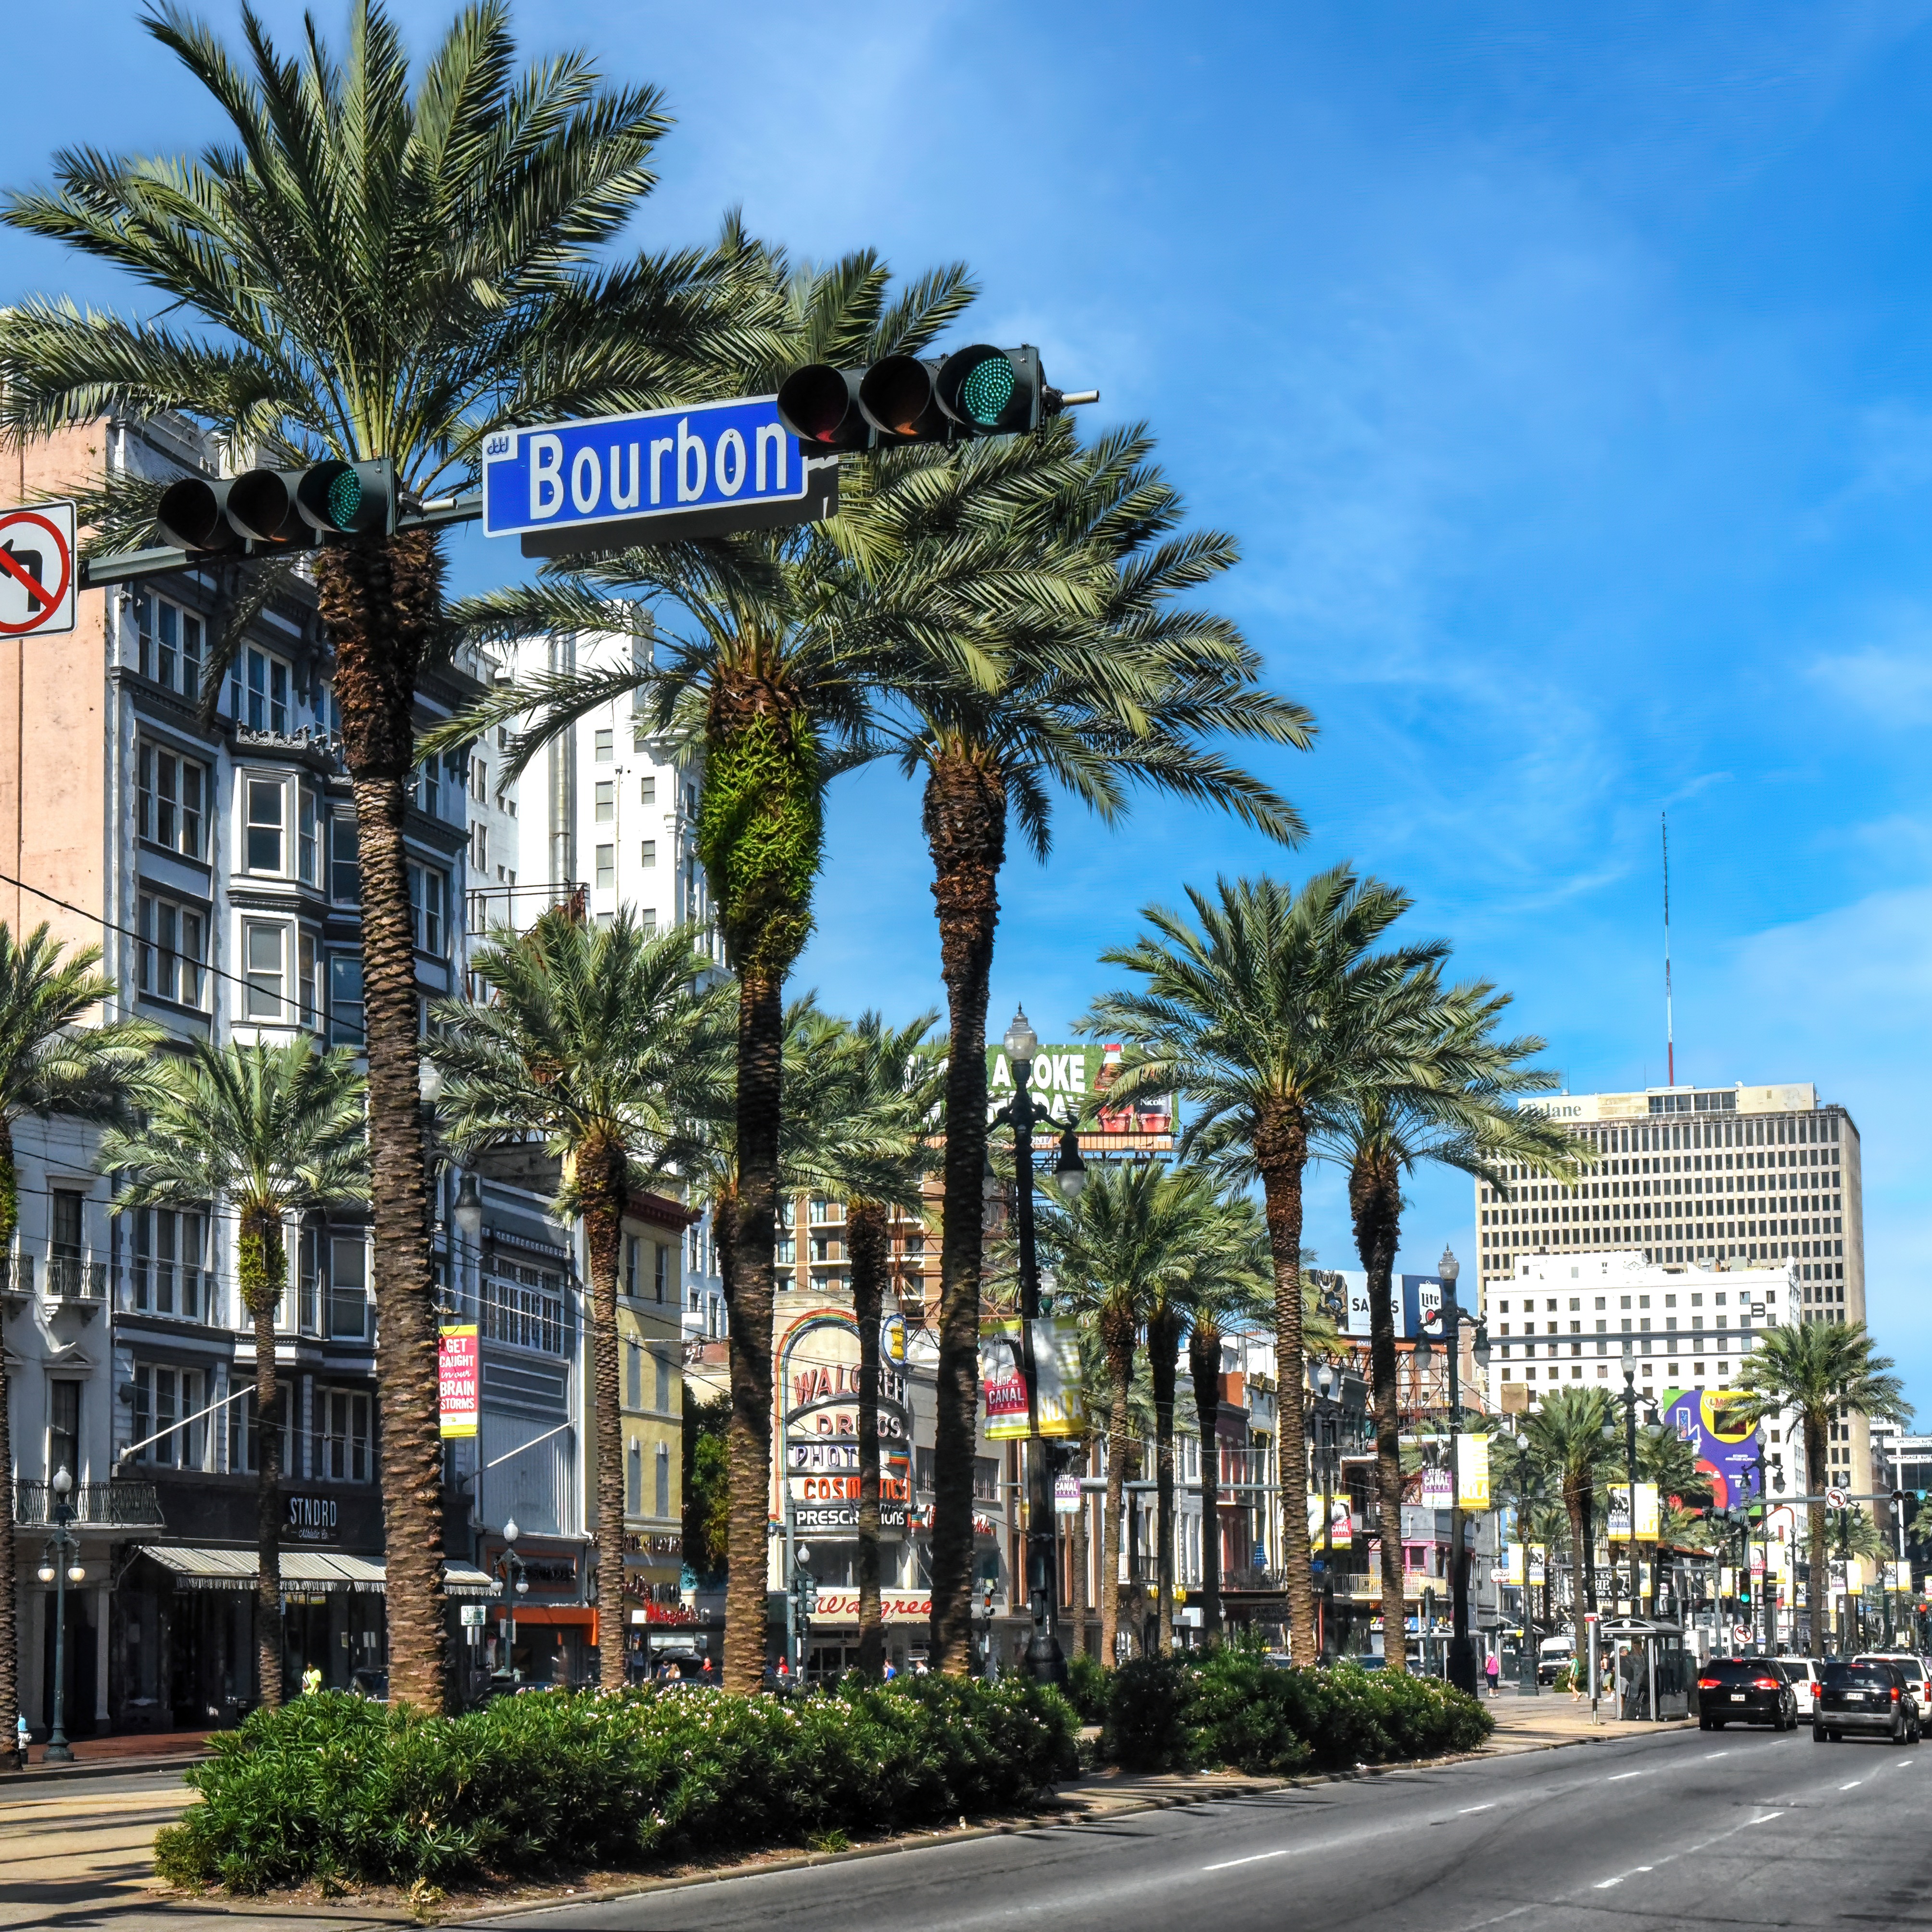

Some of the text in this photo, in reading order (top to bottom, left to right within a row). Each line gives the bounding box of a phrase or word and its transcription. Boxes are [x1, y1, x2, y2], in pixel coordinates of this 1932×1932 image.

[530, 416, 788, 520] Bourbon
[991, 1054, 1012, 1087] A
[1140, 1098, 1166, 1106] Nicole
[1421, 1293, 1439, 1308] Lite
[446, 1338, 468, 1354] GET
[439, 1355, 474, 1368] CAUGHT
[441, 1370, 472, 1379] in our
[991, 1375, 1011, 1387] SHOP
[440, 1380, 475, 1398] BRAIN
[989, 1387, 1025, 1405] CANAL
[441, 1398, 475, 1410] STORMS
[1038, 1395, 1083, 1422] NOLA
[816, 1413, 902, 1438] DRGS
[796, 1445, 857, 1467] PHOT
[1055, 1482, 1078, 1491] CANAL
[1424, 1476, 1449, 1486] CANAL
[291, 1497, 336, 1526] STNDRD
[1331, 1525, 1349, 1533] CANAL
